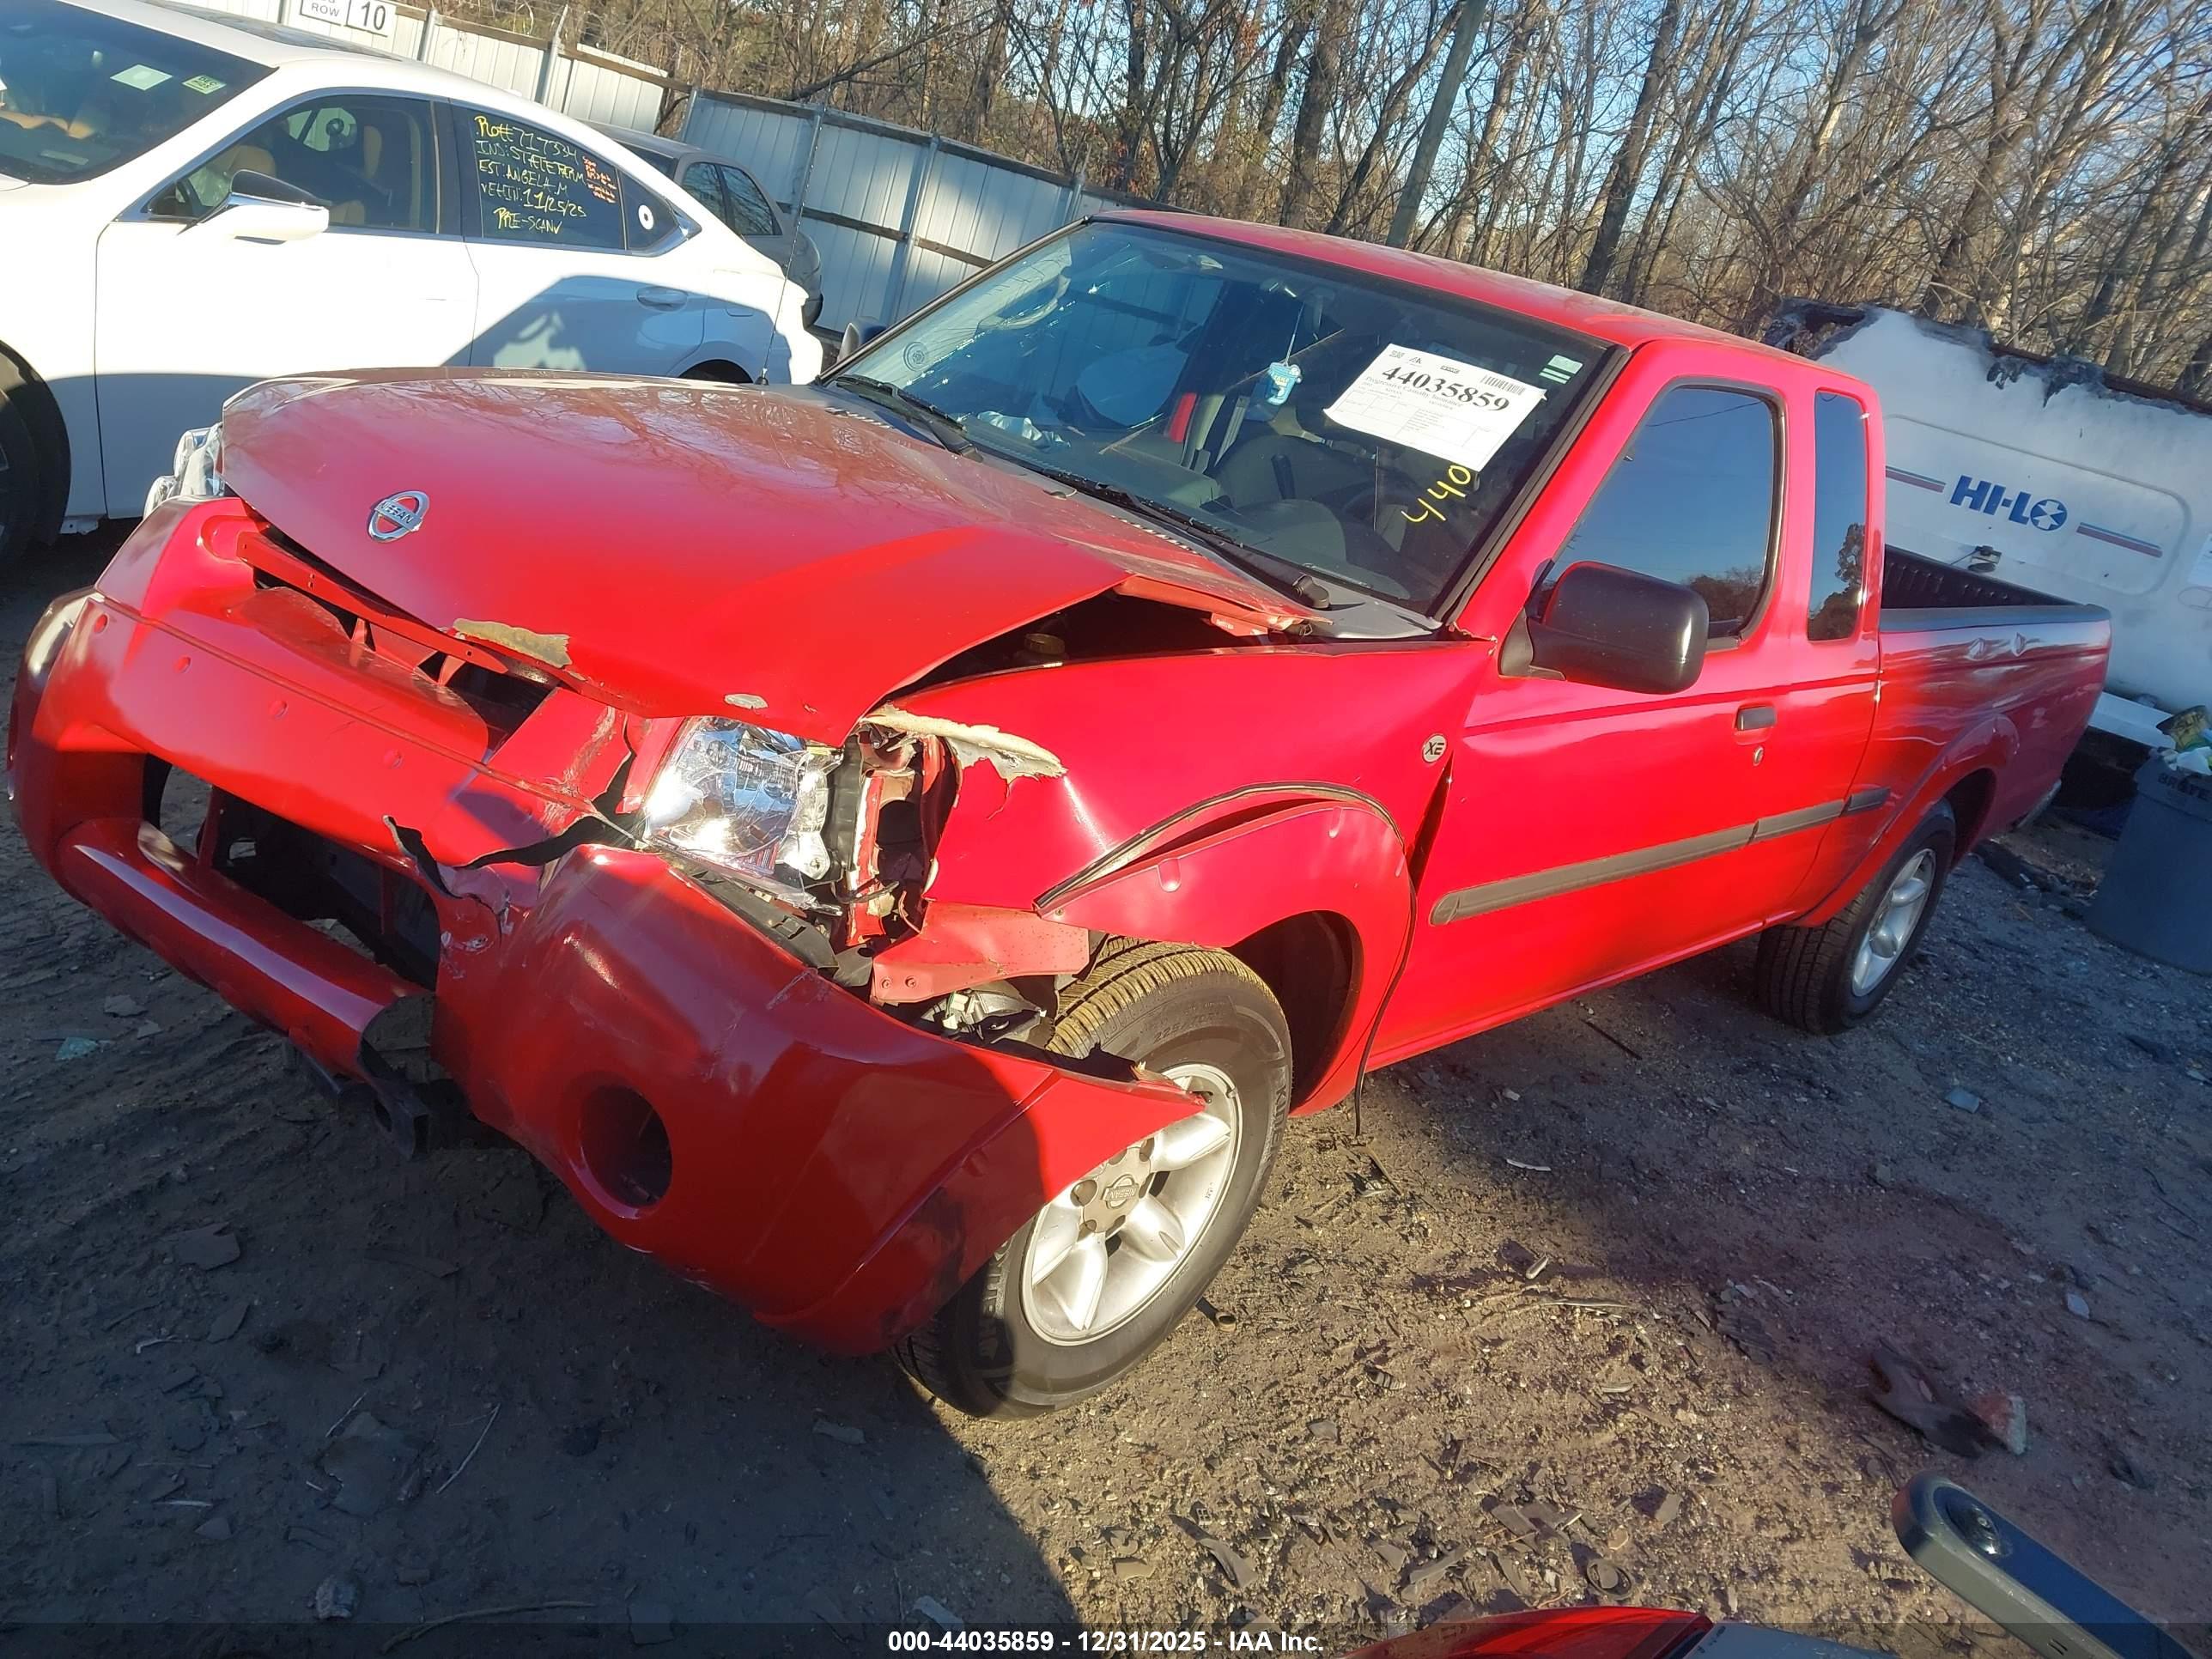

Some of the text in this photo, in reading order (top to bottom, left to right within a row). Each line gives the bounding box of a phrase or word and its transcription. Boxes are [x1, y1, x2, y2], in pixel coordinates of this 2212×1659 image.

[311, 2, 340, 17] ROW
[361, 1, 386, 31] 10
[1382, 366, 1510, 411] 44035859
[1949, 475, 2068, 532] HI-LO
[1425, 742, 1444, 756] XE
